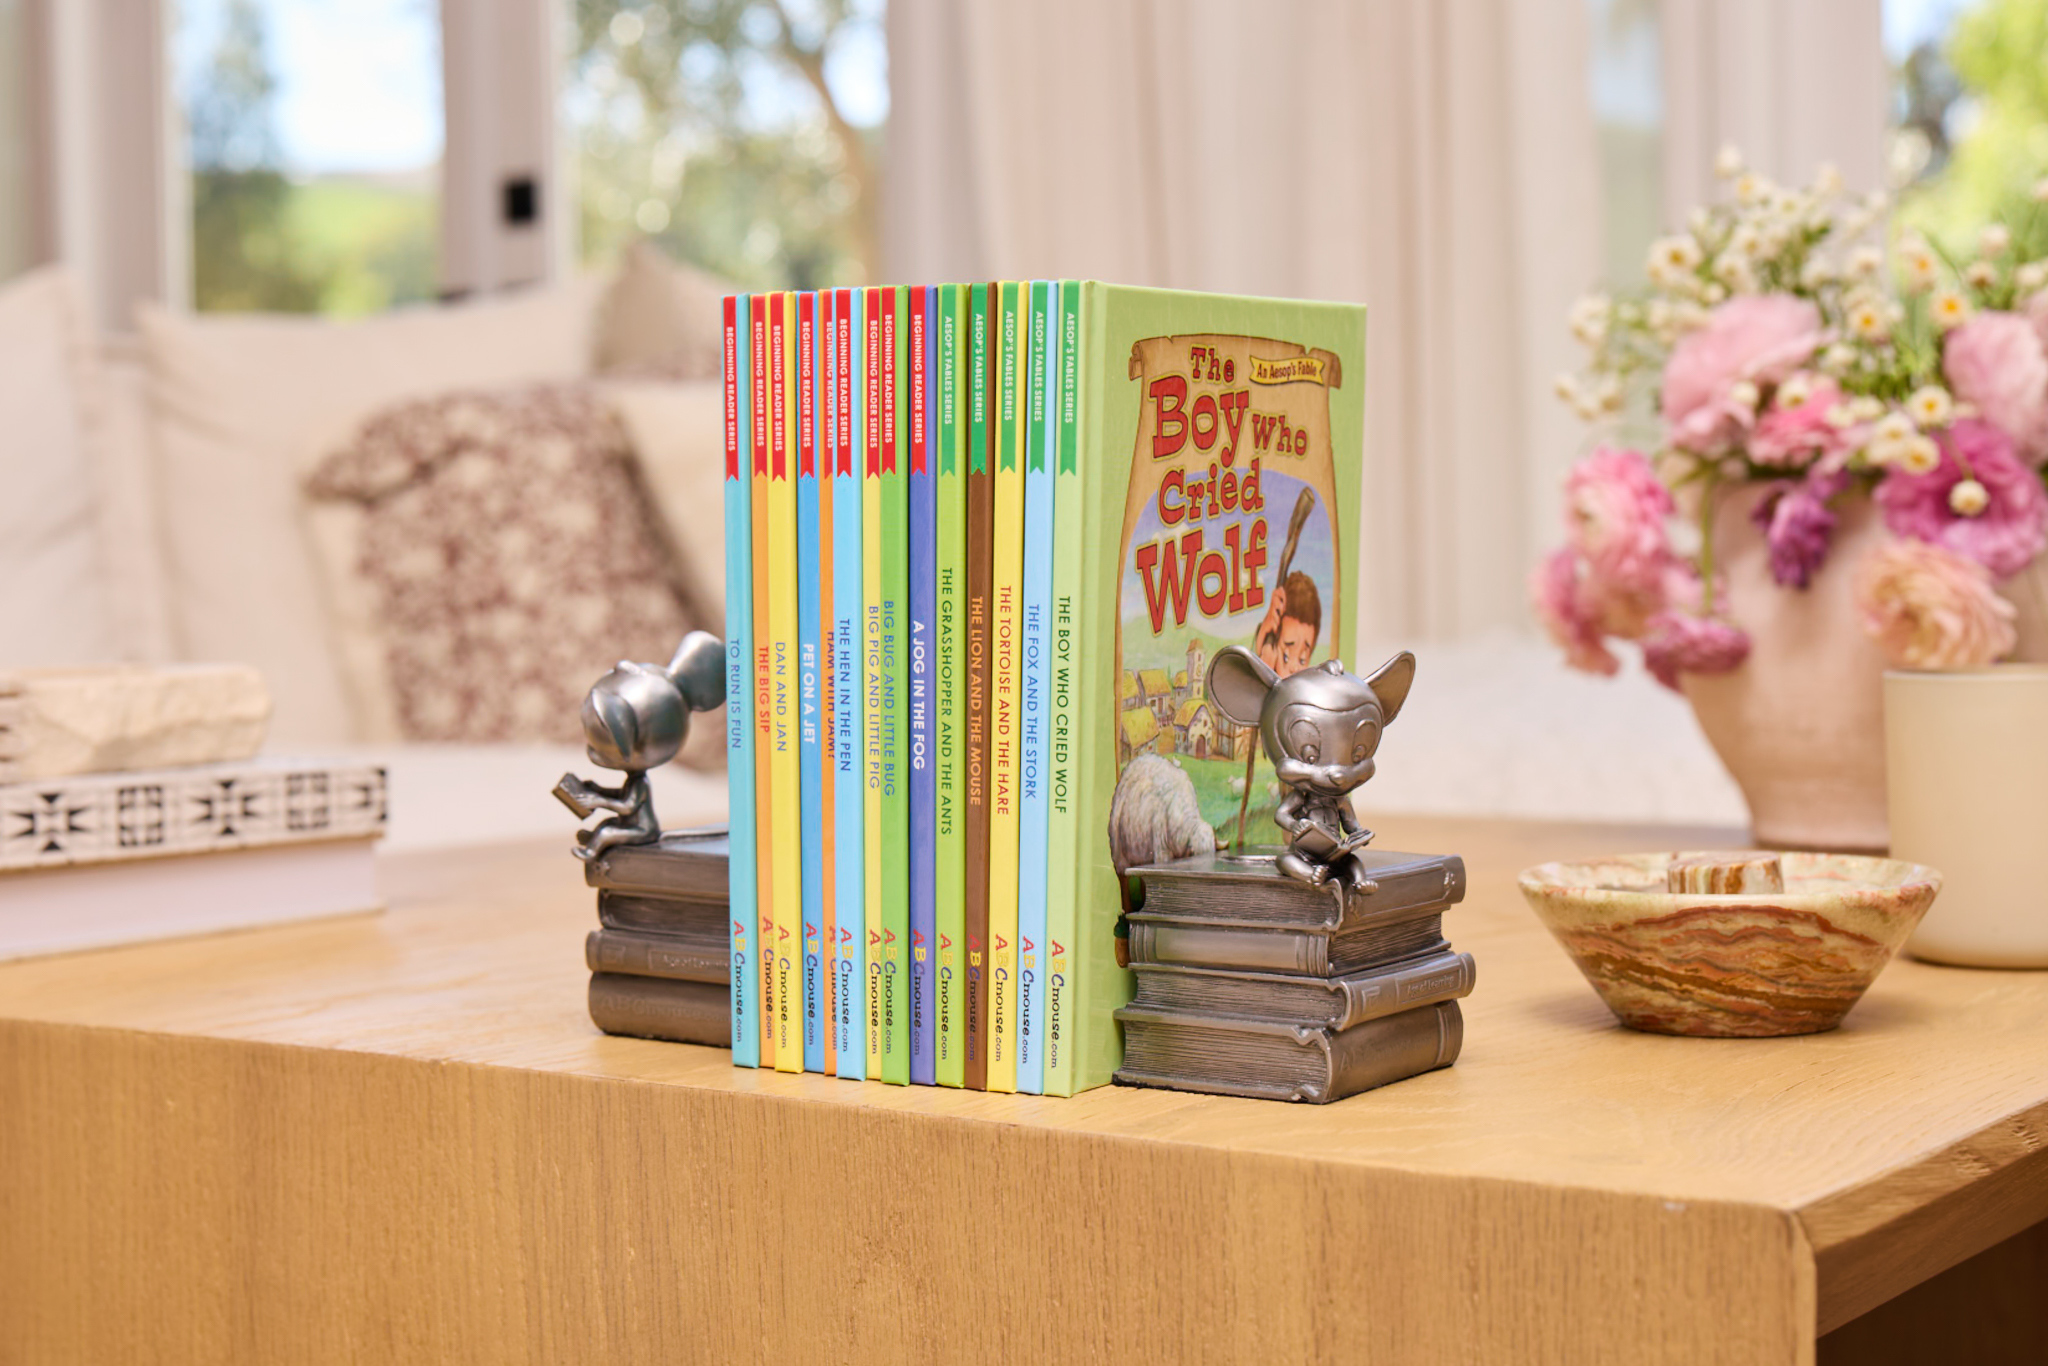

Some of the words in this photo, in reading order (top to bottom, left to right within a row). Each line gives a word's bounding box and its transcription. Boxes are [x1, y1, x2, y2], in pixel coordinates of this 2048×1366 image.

[839, 319, 848, 375] BEGINNING
[885, 314, 893, 372] BEGINNING
[914, 314, 922, 372] BEGINNING
[944, 316, 952, 356] AESOP'S
[975, 314, 983, 354] AESOP'S
[1005, 311, 1014, 351] AESOP'S
[1035, 312, 1043, 352] AESOP'S
[1066, 313, 1075, 353] AESOP'S
[726, 327, 734, 382] BEGINNING
[755, 322, 763, 377] BEGINNING
[1191, 346, 1235, 383] The
[944, 359, 952, 392] FABLES
[975, 356, 983, 389] FABLES
[1005, 354, 1013, 387] FABLES
[1035, 355, 1043, 388] FABLES
[1065, 356, 1074, 389] FABLES
[1257, 363, 1267, 378] An
[1269, 363, 1296, 380] Aesop's
[1298, 360, 1317, 377] Fable
[756, 379, 764, 414] READER
[774, 383, 782, 419] READER
[803, 380, 811, 415] READER
[839, 378, 848, 414] READER
[885, 374, 893, 410] READER
[914, 374, 922, 410] READER
[974, 392, 983, 423] SERIES
[1004, 390, 1013, 420] SERIES
[1034, 390, 1042, 421] SERIES
[1065, 392, 1074, 423] SERIES
[944, 394, 952, 424] SERIES
[1149, 375, 1249, 468] Boy
[775, 421, 783, 451] SERIES
[803, 417, 811, 448] SERIES
[839, 416, 848, 447] SERIES
[870, 418, 878, 448] SERIES
[885, 412, 893, 443] SERIES
[914, 412, 922, 444] SERIES
[1158, 456, 1264, 525] Cried
[942, 568, 953, 594] THE
[1136, 519, 1268, 635] Wolf
[884, 600, 894, 629] BIG
[972, 597, 983, 624] THE
[1000, 586, 1011, 613] THE
[1058, 596, 1070, 623] THE
[840, 619, 850, 645] THE
[869, 606, 879, 634] BIG
[913, 621, 925, 633] A
[1028, 605, 1039, 631] THE
[730, 639, 740, 658] TO
[759, 647, 769, 672] THE
[776, 642, 786, 675] DAN
[803, 644, 814, 668] PET
[869, 640, 879, 667] PIG
[884, 635, 894, 668] BUG
[913, 638, 925, 674] JOG
[941, 601, 953, 716] GRASSHOPPER
[971, 630, 983, 668] LION
[999, 618, 1011, 694] TORTOISE
[1028, 638, 1039, 669] FOX
[1058, 630, 1070, 662] BOY
[731, 665, 741, 694] RUN
[840, 651, 850, 682] HEN
[759, 678, 769, 705] BIG
[776, 681, 786, 715] AND
[803, 673, 814, 698] ON
[840, 689, 850, 704] IN
[869, 673, 879, 708] AND
[884, 674, 894, 709] AND
[913, 680, 925, 697] IN
[971, 674, 982, 710] AND
[1027, 676, 1038, 711] AND
[1057, 668, 1069, 707] WHO
[731, 702, 741, 713] IS
[760, 711, 770, 733] SIP
[804, 703, 815, 715] A
[840, 711, 850, 737] THE
[913, 702, 925, 729] THE
[998, 700, 1010, 735] AND
[731, 720, 741, 748] FUN
[777, 722, 787, 751] JAN
[804, 720, 815, 744] JET
[869, 715, 879, 755] LITTLE
[884, 715, 894, 757] LITTLE
[941, 722, 952, 757] AND
[971, 715, 982, 742] THE
[1026, 718, 1037, 744] THE
[1056, 714, 1068, 762] CRIED
[840, 743, 851, 771] PEN
[913, 734, 925, 770] FOG
[998, 740, 1010, 767] THE
[870, 762, 880, 788] PIG
[884, 763, 895, 796] BUG
[941, 763, 952, 789] THE
[970, 747, 981, 805] MOUSE
[1025, 750, 1037, 799] STORK
[997, 773, 1009, 815] HARE
[1055, 770, 1067, 813] WOLF
[941, 795, 952, 835] ANTS
[734, 920, 746, 1042] ABCmouse.com
[763, 916, 774, 1039] ABCmouse.com
[779, 925, 790, 1048] ABCmouse.com
[806, 922, 819, 1045] ABCmouse.com
[841, 927, 853, 1051] ABCmouse.com
[870, 930, 881, 1054] ABCmouse.com
[884, 928, 897, 1054] ABCmouse.com
[913, 929, 926, 1055] ABCmouse.com
[940, 933, 953, 1060] ABCmouse.com
[969, 934, 981, 1061] ABCmouse.com
[995, 934, 1009, 1061] ABCmouse.com
[1022, 936, 1035, 1064] ABCmouse.com
[1051, 940, 1066, 1068] ABCmouse.com
